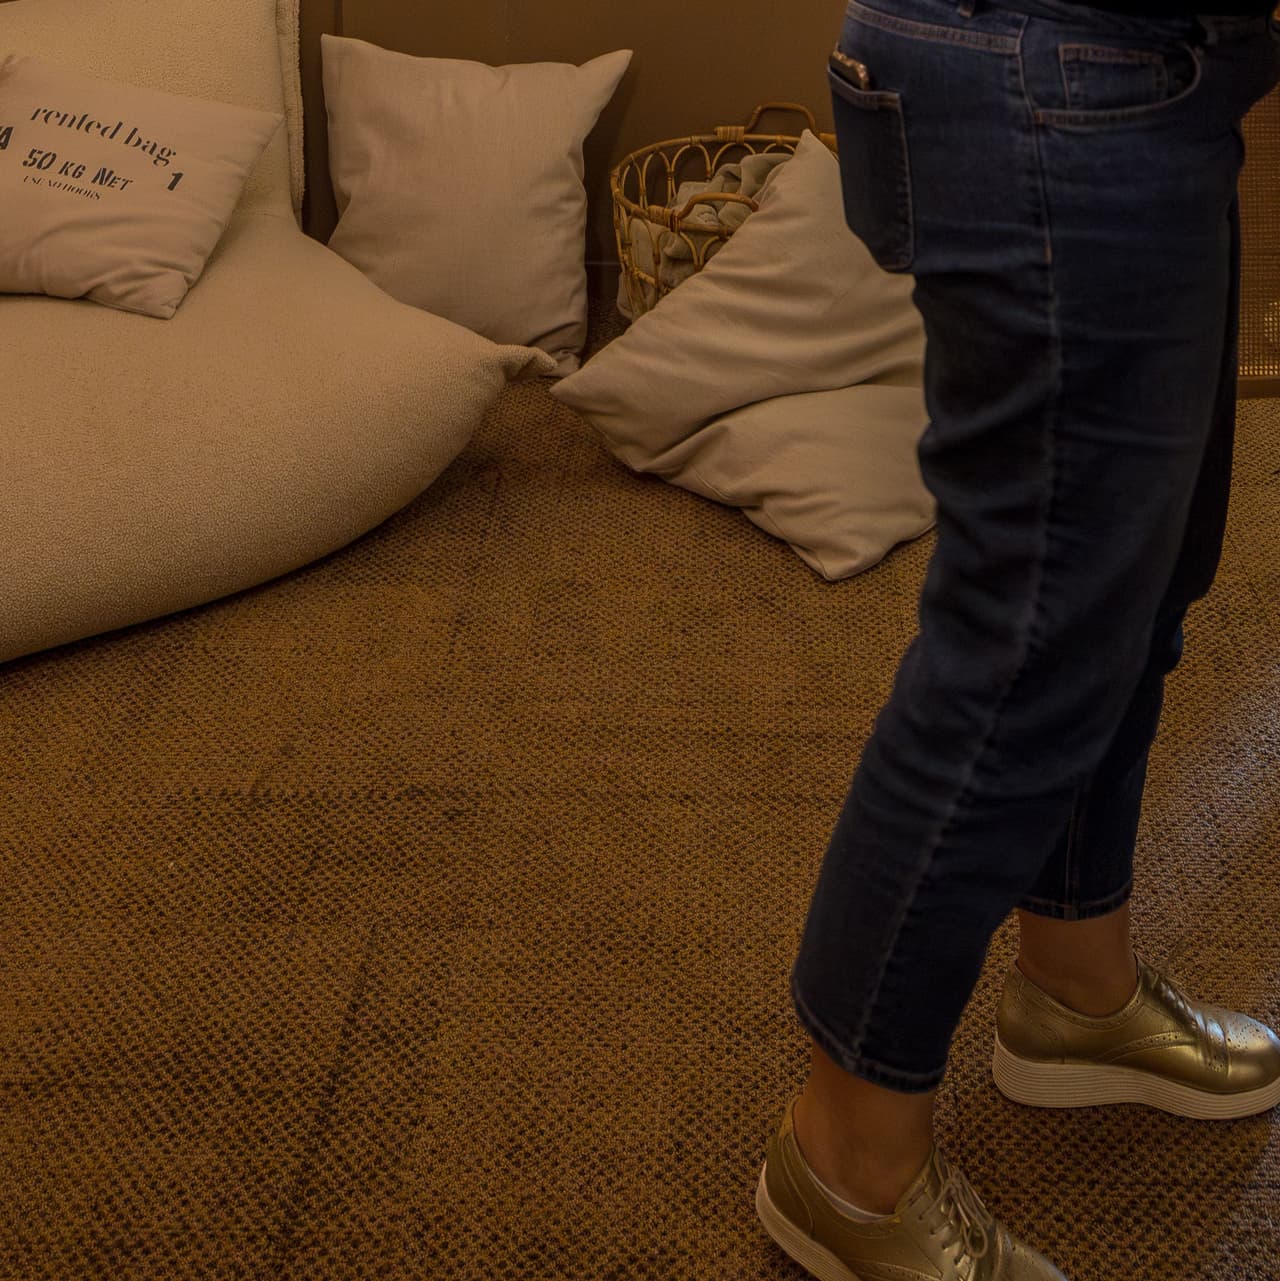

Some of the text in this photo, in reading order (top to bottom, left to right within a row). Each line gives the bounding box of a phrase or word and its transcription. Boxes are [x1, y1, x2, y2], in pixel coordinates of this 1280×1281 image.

[30, 107, 176, 167] rented bag
[22, 147, 57, 170] 50
[58, 160, 86, 179] KG
[167, 171, 184, 192] 1
